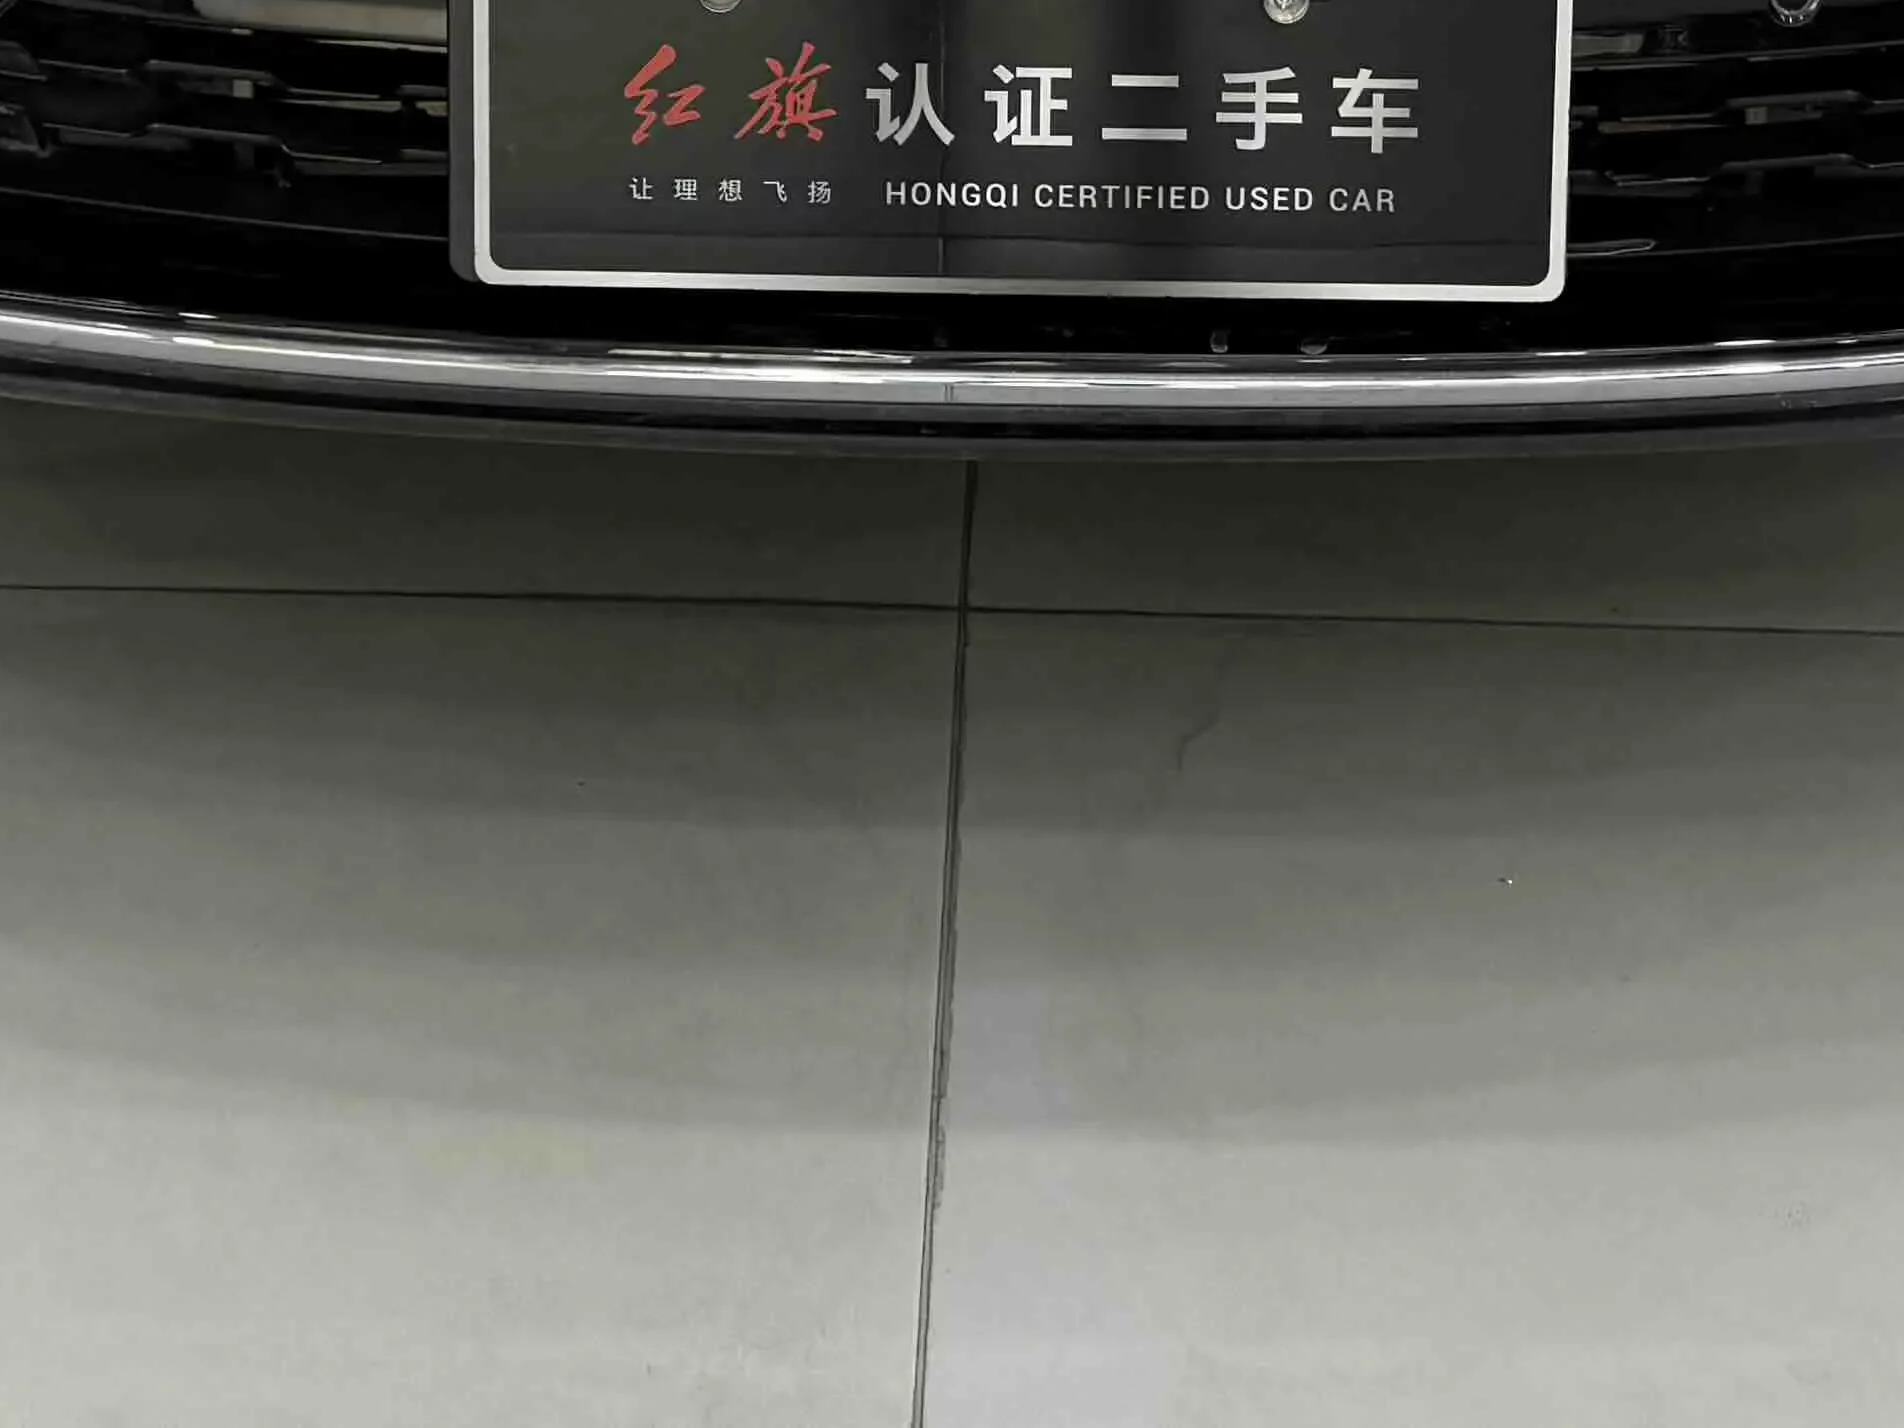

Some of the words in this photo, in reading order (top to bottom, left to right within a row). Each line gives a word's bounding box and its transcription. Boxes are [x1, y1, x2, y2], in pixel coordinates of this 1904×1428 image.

[885, 180, 1019, 210] HONGQI
[1033, 183, 1210, 211] CERTIFIED
[1225, 185, 1314, 213] USED
[1329, 186, 1396, 214] CAR
